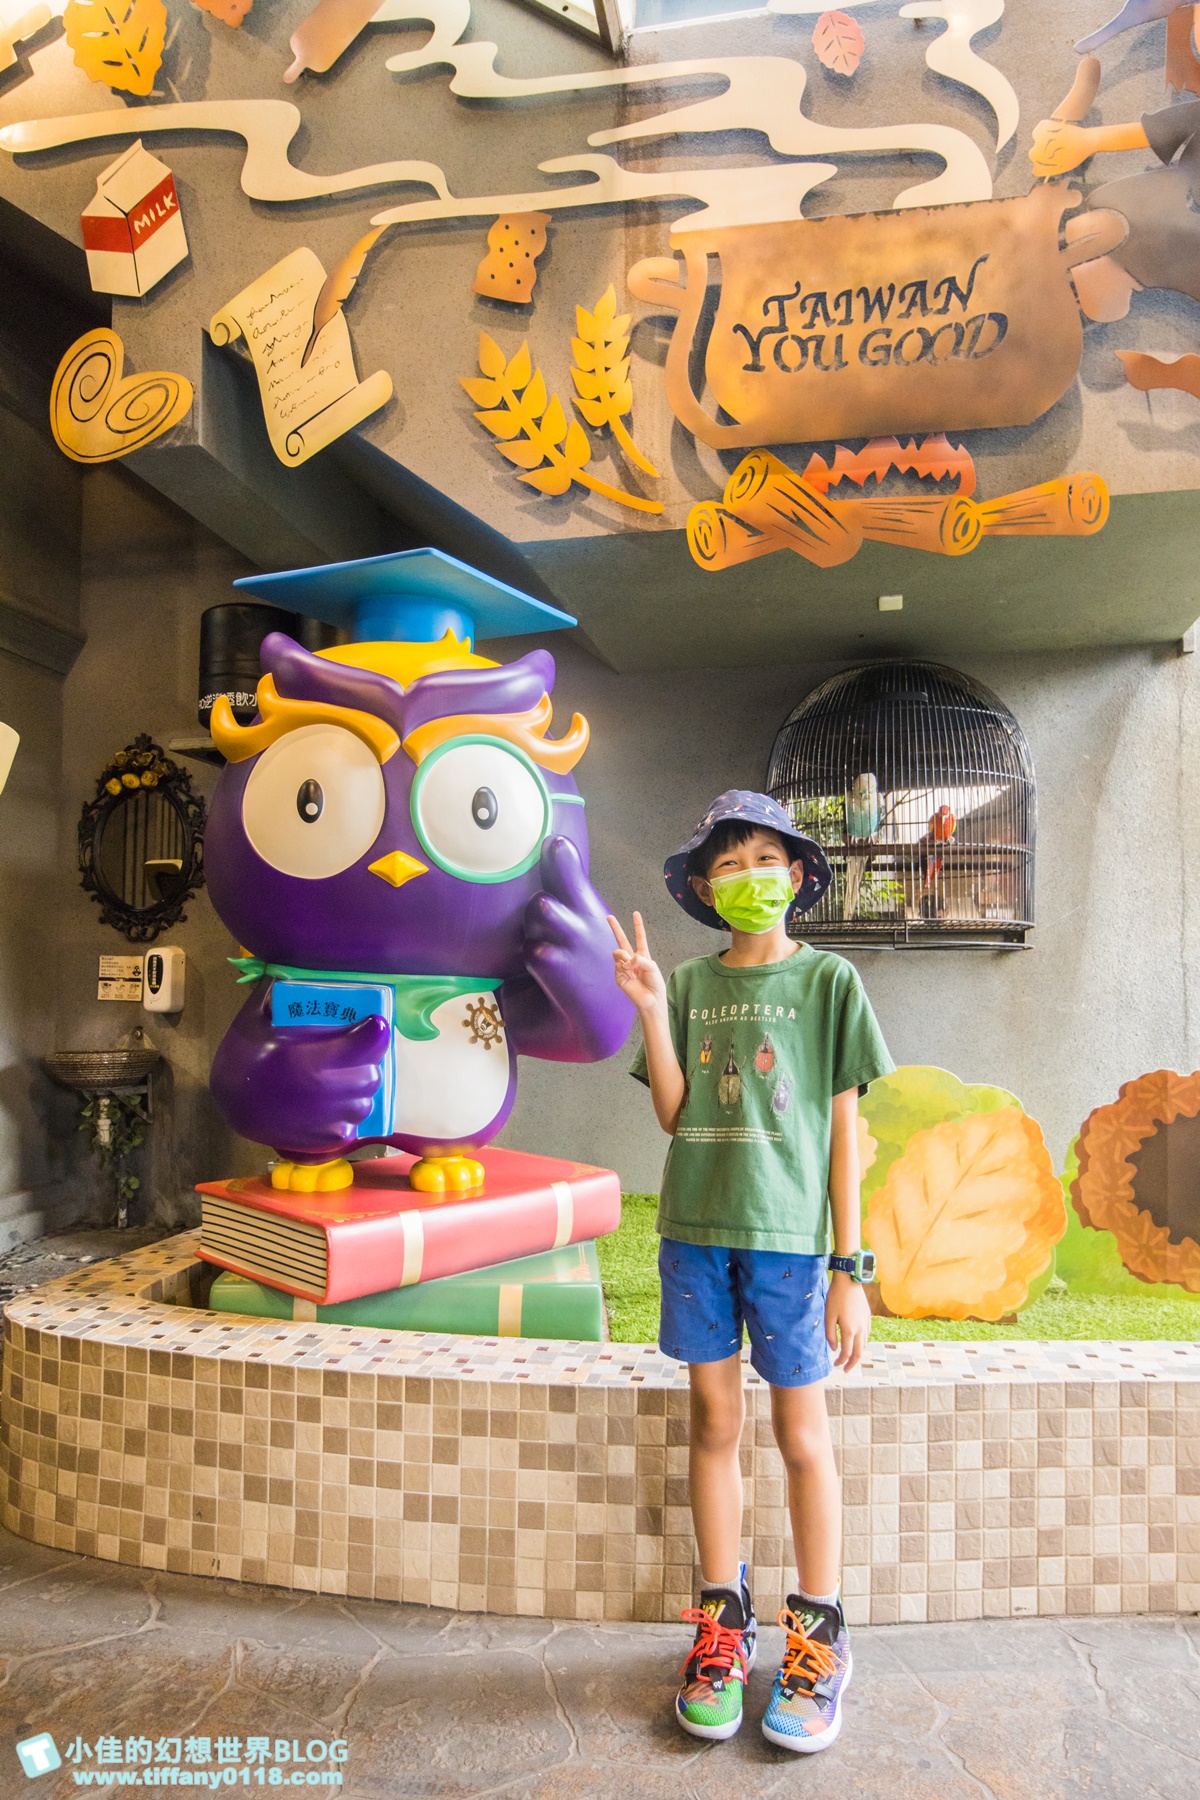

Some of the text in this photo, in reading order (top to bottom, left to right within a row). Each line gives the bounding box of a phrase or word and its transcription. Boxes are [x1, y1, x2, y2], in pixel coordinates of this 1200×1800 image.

[133, 191, 176, 235] MILK
[763, 254, 990, 330] TAIWAN
[732, 312, 1009, 373] YOU GOOD
[287, 1000, 358, 1024] 魔法寶典
[689, 1003, 796, 1020] COLEOPTERA
[750, 1015, 777, 1023] BEETLES
